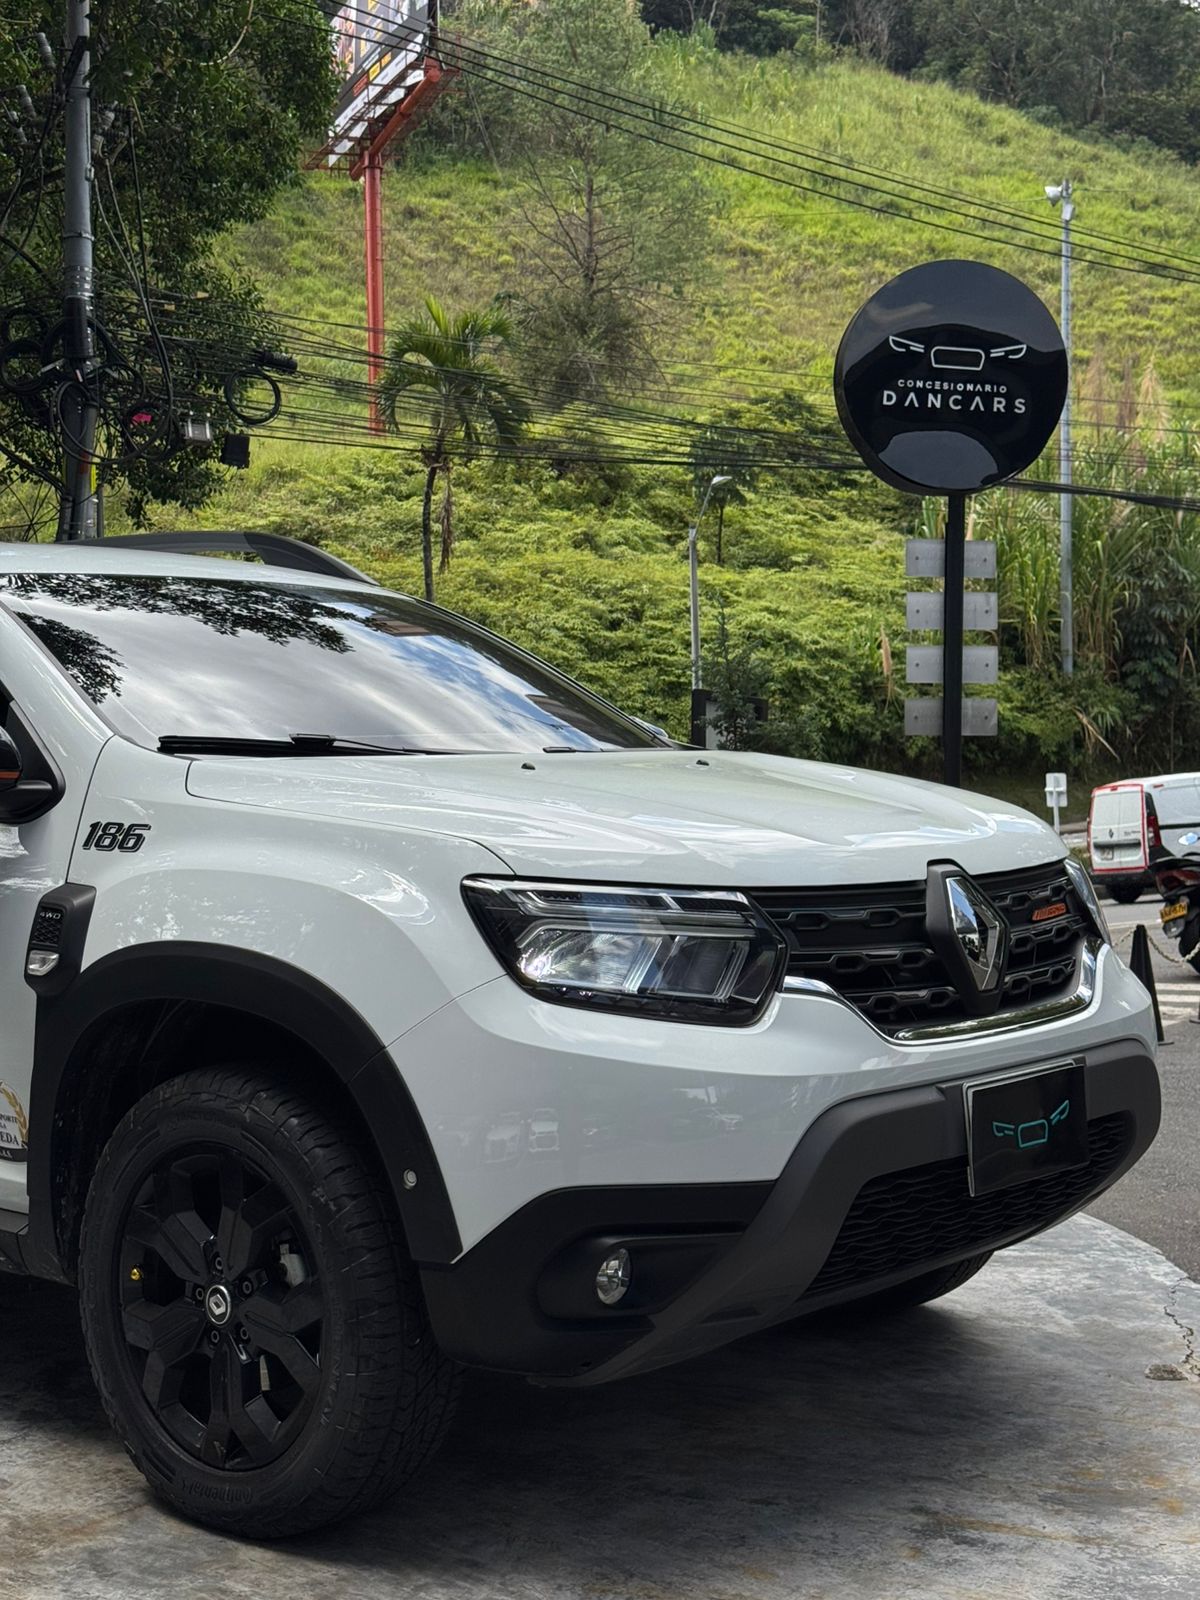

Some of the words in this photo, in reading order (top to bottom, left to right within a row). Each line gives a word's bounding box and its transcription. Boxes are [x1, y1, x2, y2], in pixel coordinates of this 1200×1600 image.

[898, 379, 1007, 394] CONCESIONARIO
[882, 390, 1026, 414] DANCARS
[82, 821, 152, 853] 186
[40, 911, 61, 920] 4WD
